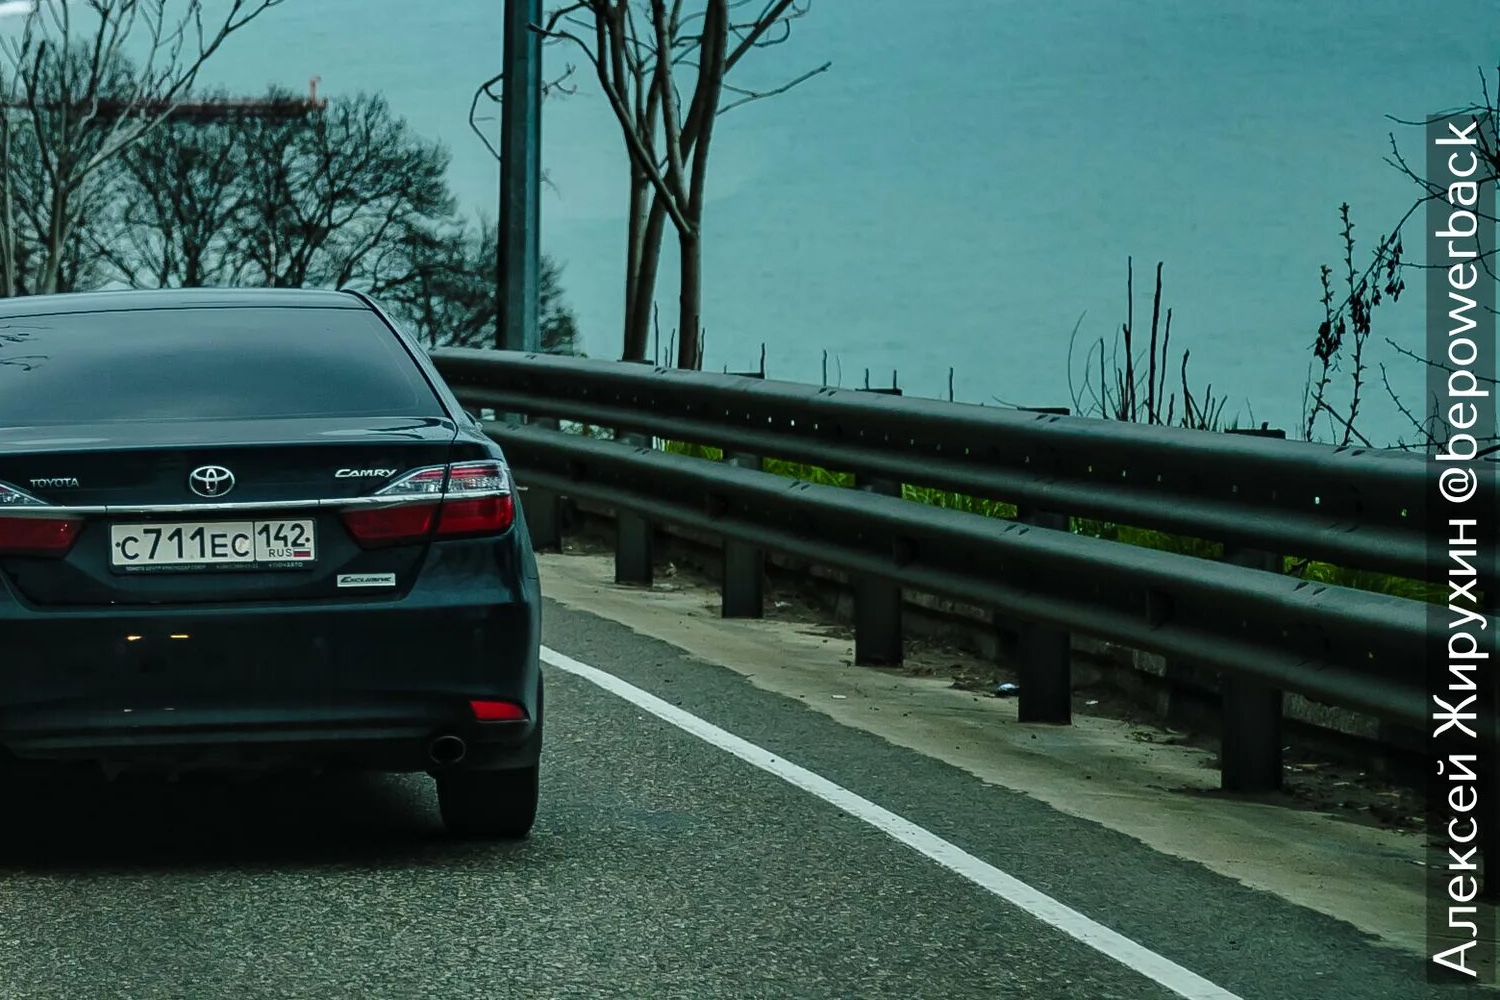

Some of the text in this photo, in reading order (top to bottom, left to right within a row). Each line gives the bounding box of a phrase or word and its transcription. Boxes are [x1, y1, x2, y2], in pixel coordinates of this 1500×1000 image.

[334, 468, 398, 478] CAMRY
[30, 477, 80, 488] TOYOTA
[268, 548, 293, 558] RUS
